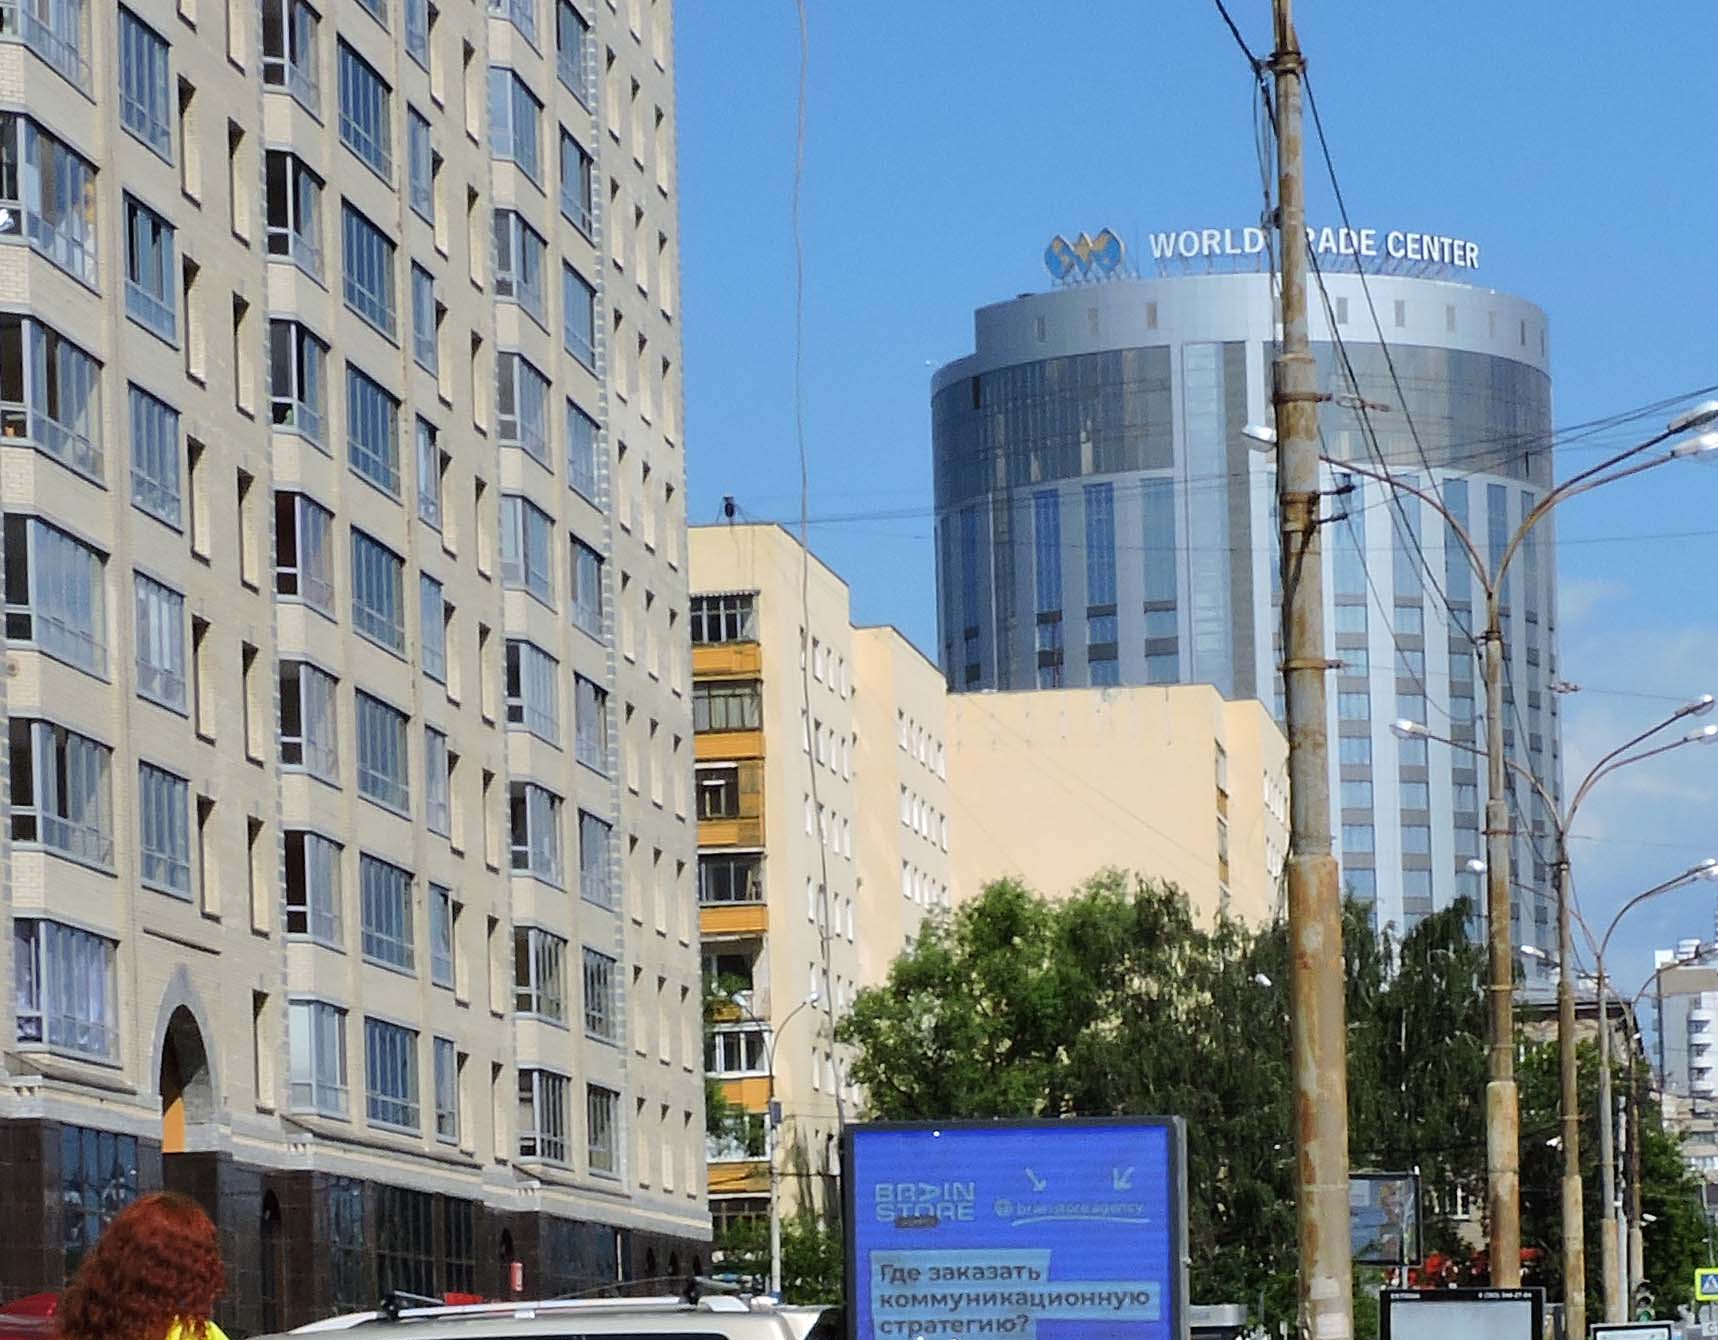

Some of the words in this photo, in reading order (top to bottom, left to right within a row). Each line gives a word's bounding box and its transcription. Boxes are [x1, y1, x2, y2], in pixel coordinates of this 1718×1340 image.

[1149, 227, 1264, 258] WORLD
[1303, 226, 1377, 256] RADE
[1386, 231, 1479, 269] CENTER
[875, 1182, 975, 1201] BRAIN
[875, 1201, 975, 1221] STORE
[880, 1264, 921, 1285] Где
[928, 1265, 1041, 1282] заказать
[880, 1289, 1150, 1312] коммуникационную
[879, 1315, 1030, 1339] стратегию?
